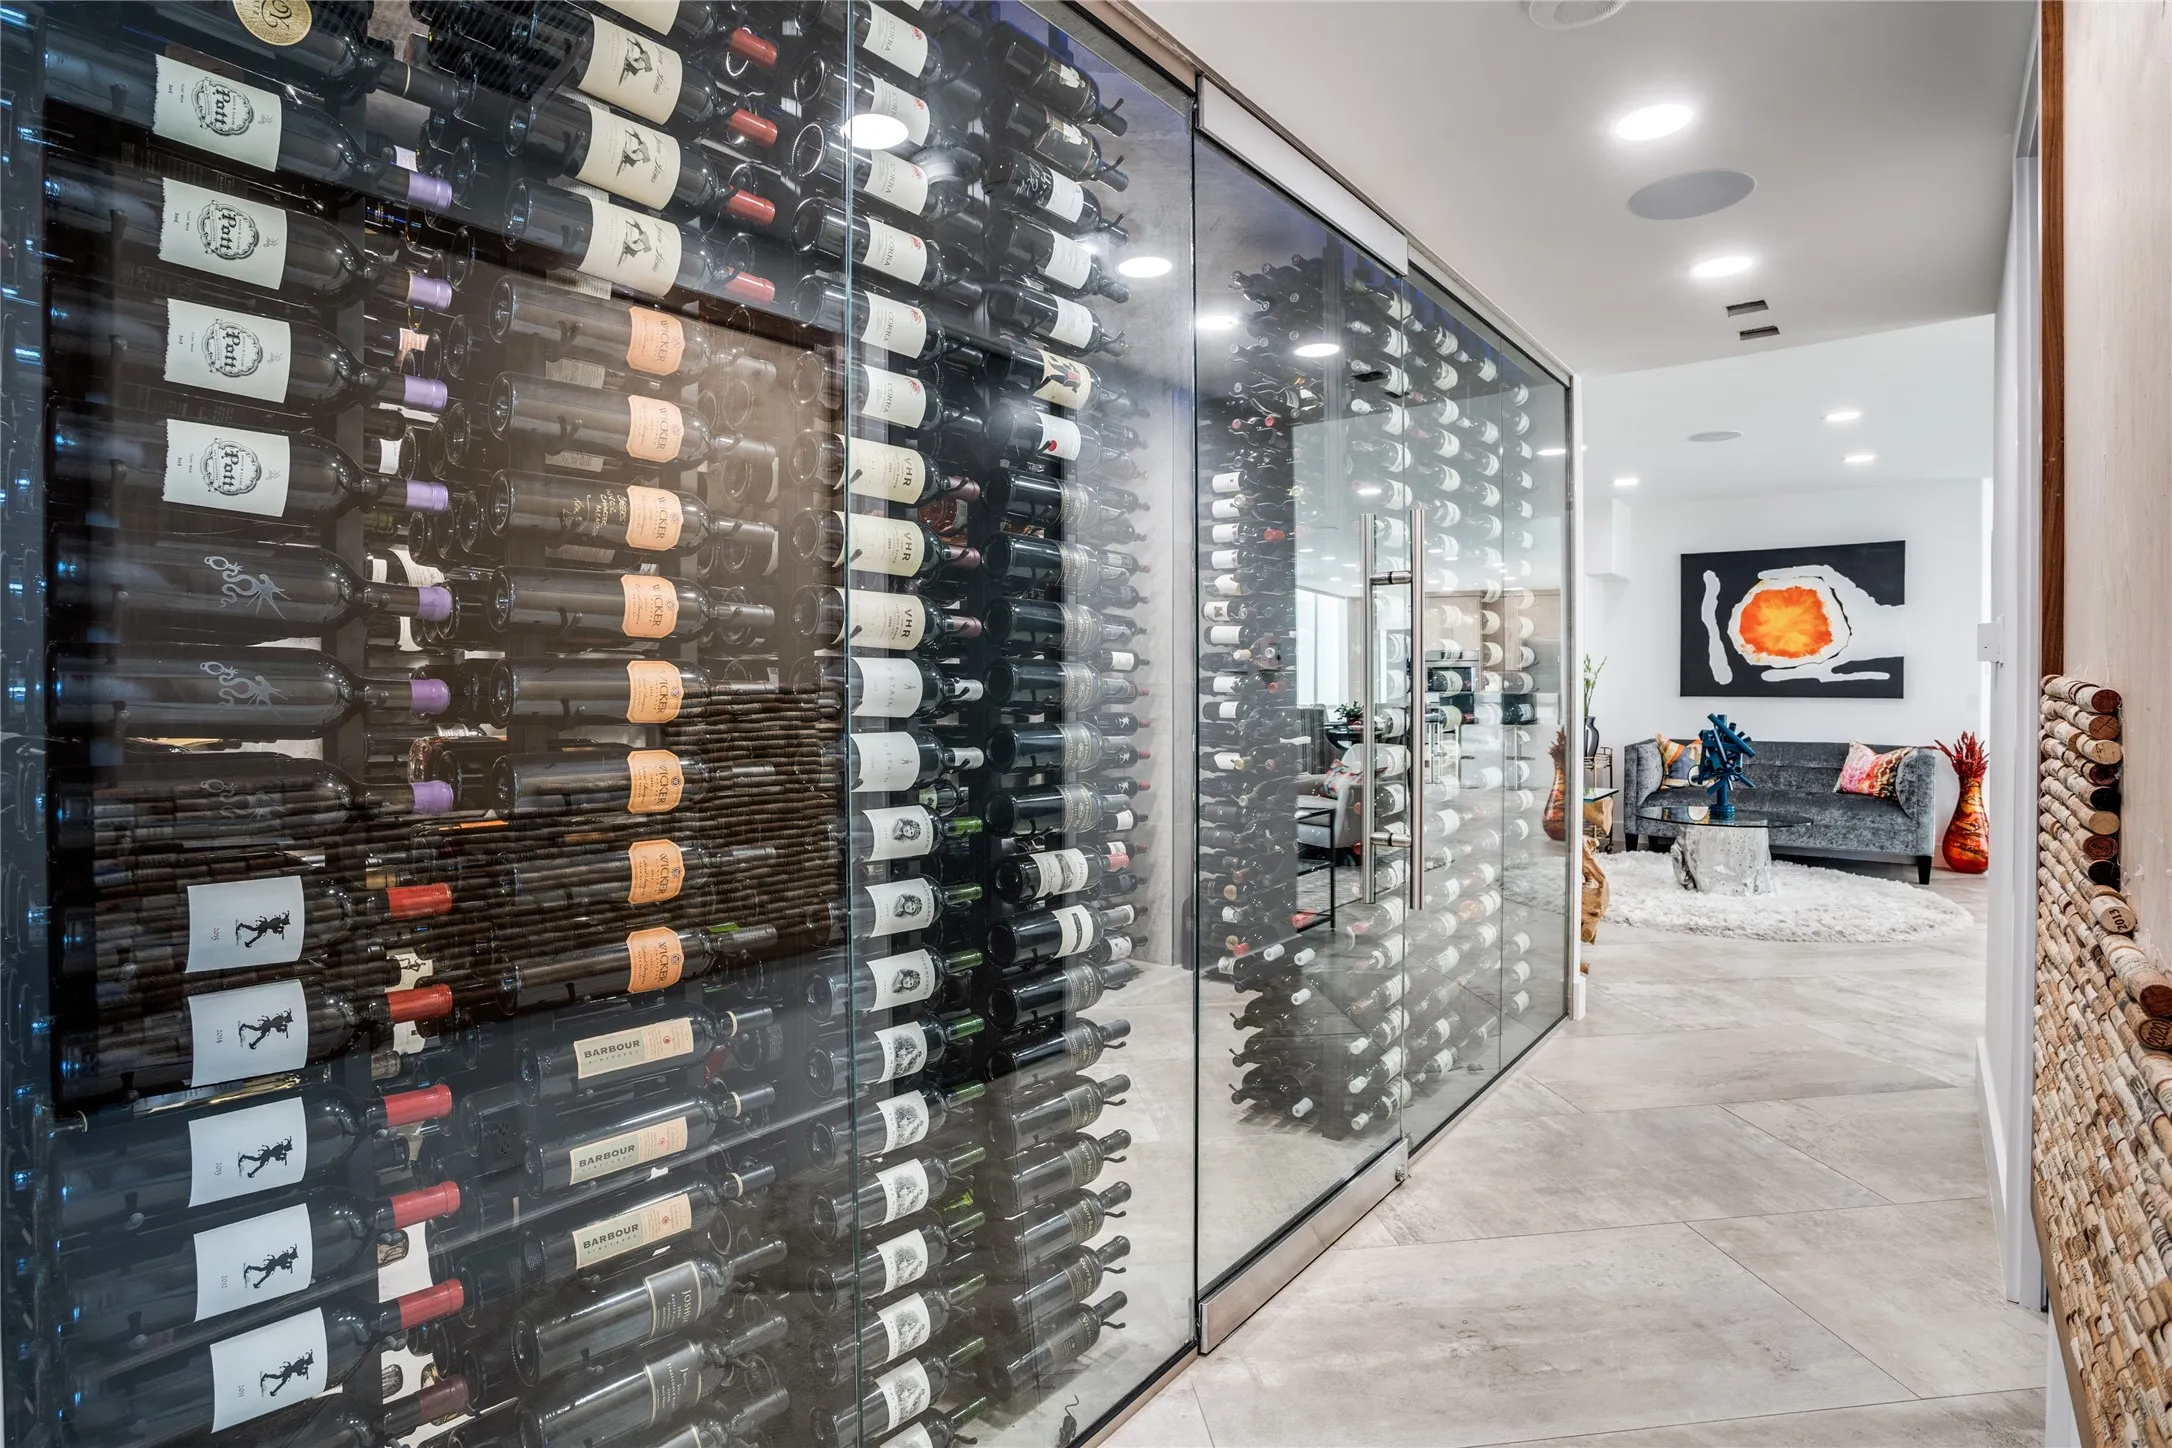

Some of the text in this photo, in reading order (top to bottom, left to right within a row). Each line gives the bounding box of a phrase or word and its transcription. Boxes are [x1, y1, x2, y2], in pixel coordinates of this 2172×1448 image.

[885, 22, 896, 51] CORRA
[213, 88, 231, 126] Pott
[884, 163, 896, 193] CORRA
[219, 212, 237, 250] Pott
[884, 236, 895, 266] CORRA
[656, 320, 670, 363] WICKER
[882, 311, 894, 342] CORRA
[223, 331, 241, 368] Pott
[882, 383, 894, 413] CORRA
[656, 408, 669, 450] WICKER
[221, 450, 239, 488] Pott
[902, 457, 913, 487] VHR
[656, 497, 668, 539] WICKER
[901, 532, 912, 561] VHR
[652, 584, 664, 627] WICKER
[901, 609, 912, 638] VHR
[656, 854, 670, 896] WICKER
[2109, 908, 2129, 931] 2013
[656, 942, 669, 983] WICKER
[2146, 1020, 2171, 1046] 2020
[584, 1040, 640, 1059] BARBOUR
[579, 1145, 635, 1168] BARBOUR
[583, 1223, 639, 1250] BARBOUR
[680, 1289, 692, 1325] JOSHUA
